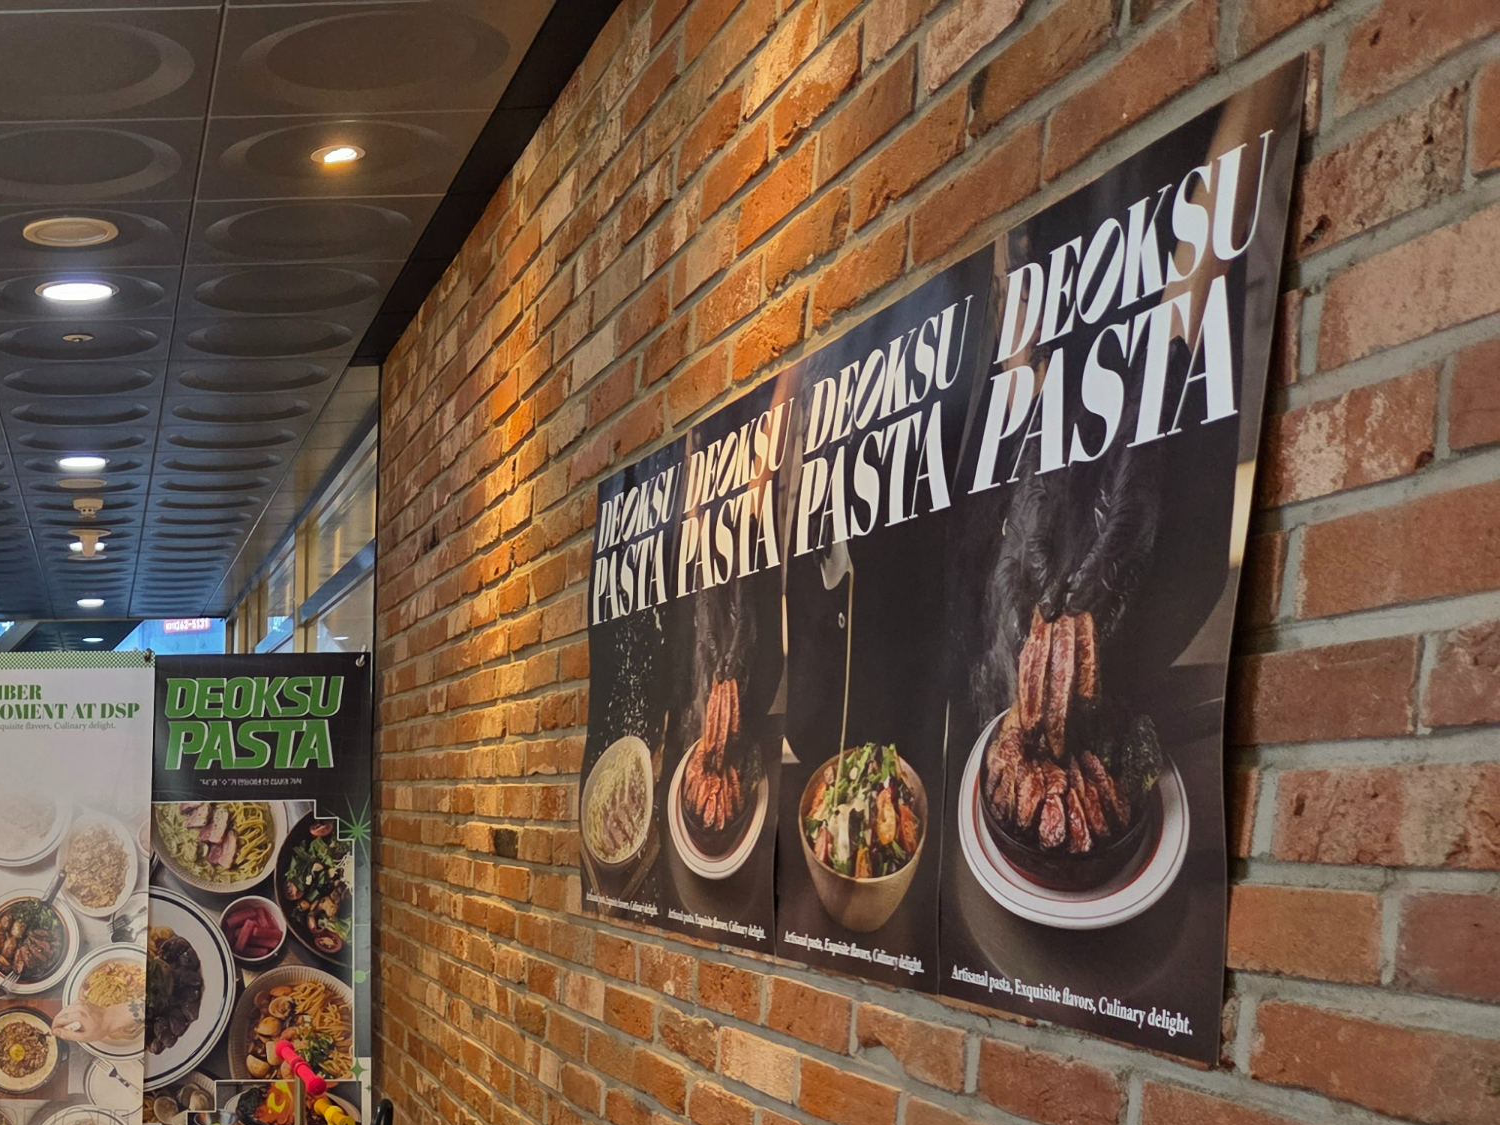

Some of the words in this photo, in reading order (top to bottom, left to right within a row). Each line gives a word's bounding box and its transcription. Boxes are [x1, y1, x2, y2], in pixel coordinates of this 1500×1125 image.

[993, 129, 1273, 364] DEOKSU
[803, 295, 973, 455] DEOKSU
[967, 274, 1238, 494] PASTA
[683, 397, 795, 514] DEOKSU
[793, 400, 951, 557] PASTA
[597, 461, 682, 554] DEOKSU
[676, 479, 781, 599] PASTA
[592, 530, 667, 626] PASTA
[53, 722, 87, 731] Culinary
[71, 703, 97, 719] AT
[100, 703, 140, 719] DSP
[164, 676, 344, 719] DEOKSU
[164, 719, 334, 770] PASTA
[951, 965, 988, 987] Artisanal
[989, 976, 1013, 995] pasta,
[1014, 979, 1061, 1003] Exquisite
[1062, 987, 1096, 1014] flavors,
[1098, 996, 1145, 1029] Culinary
[1148, 1007, 1193, 1036] delight.
